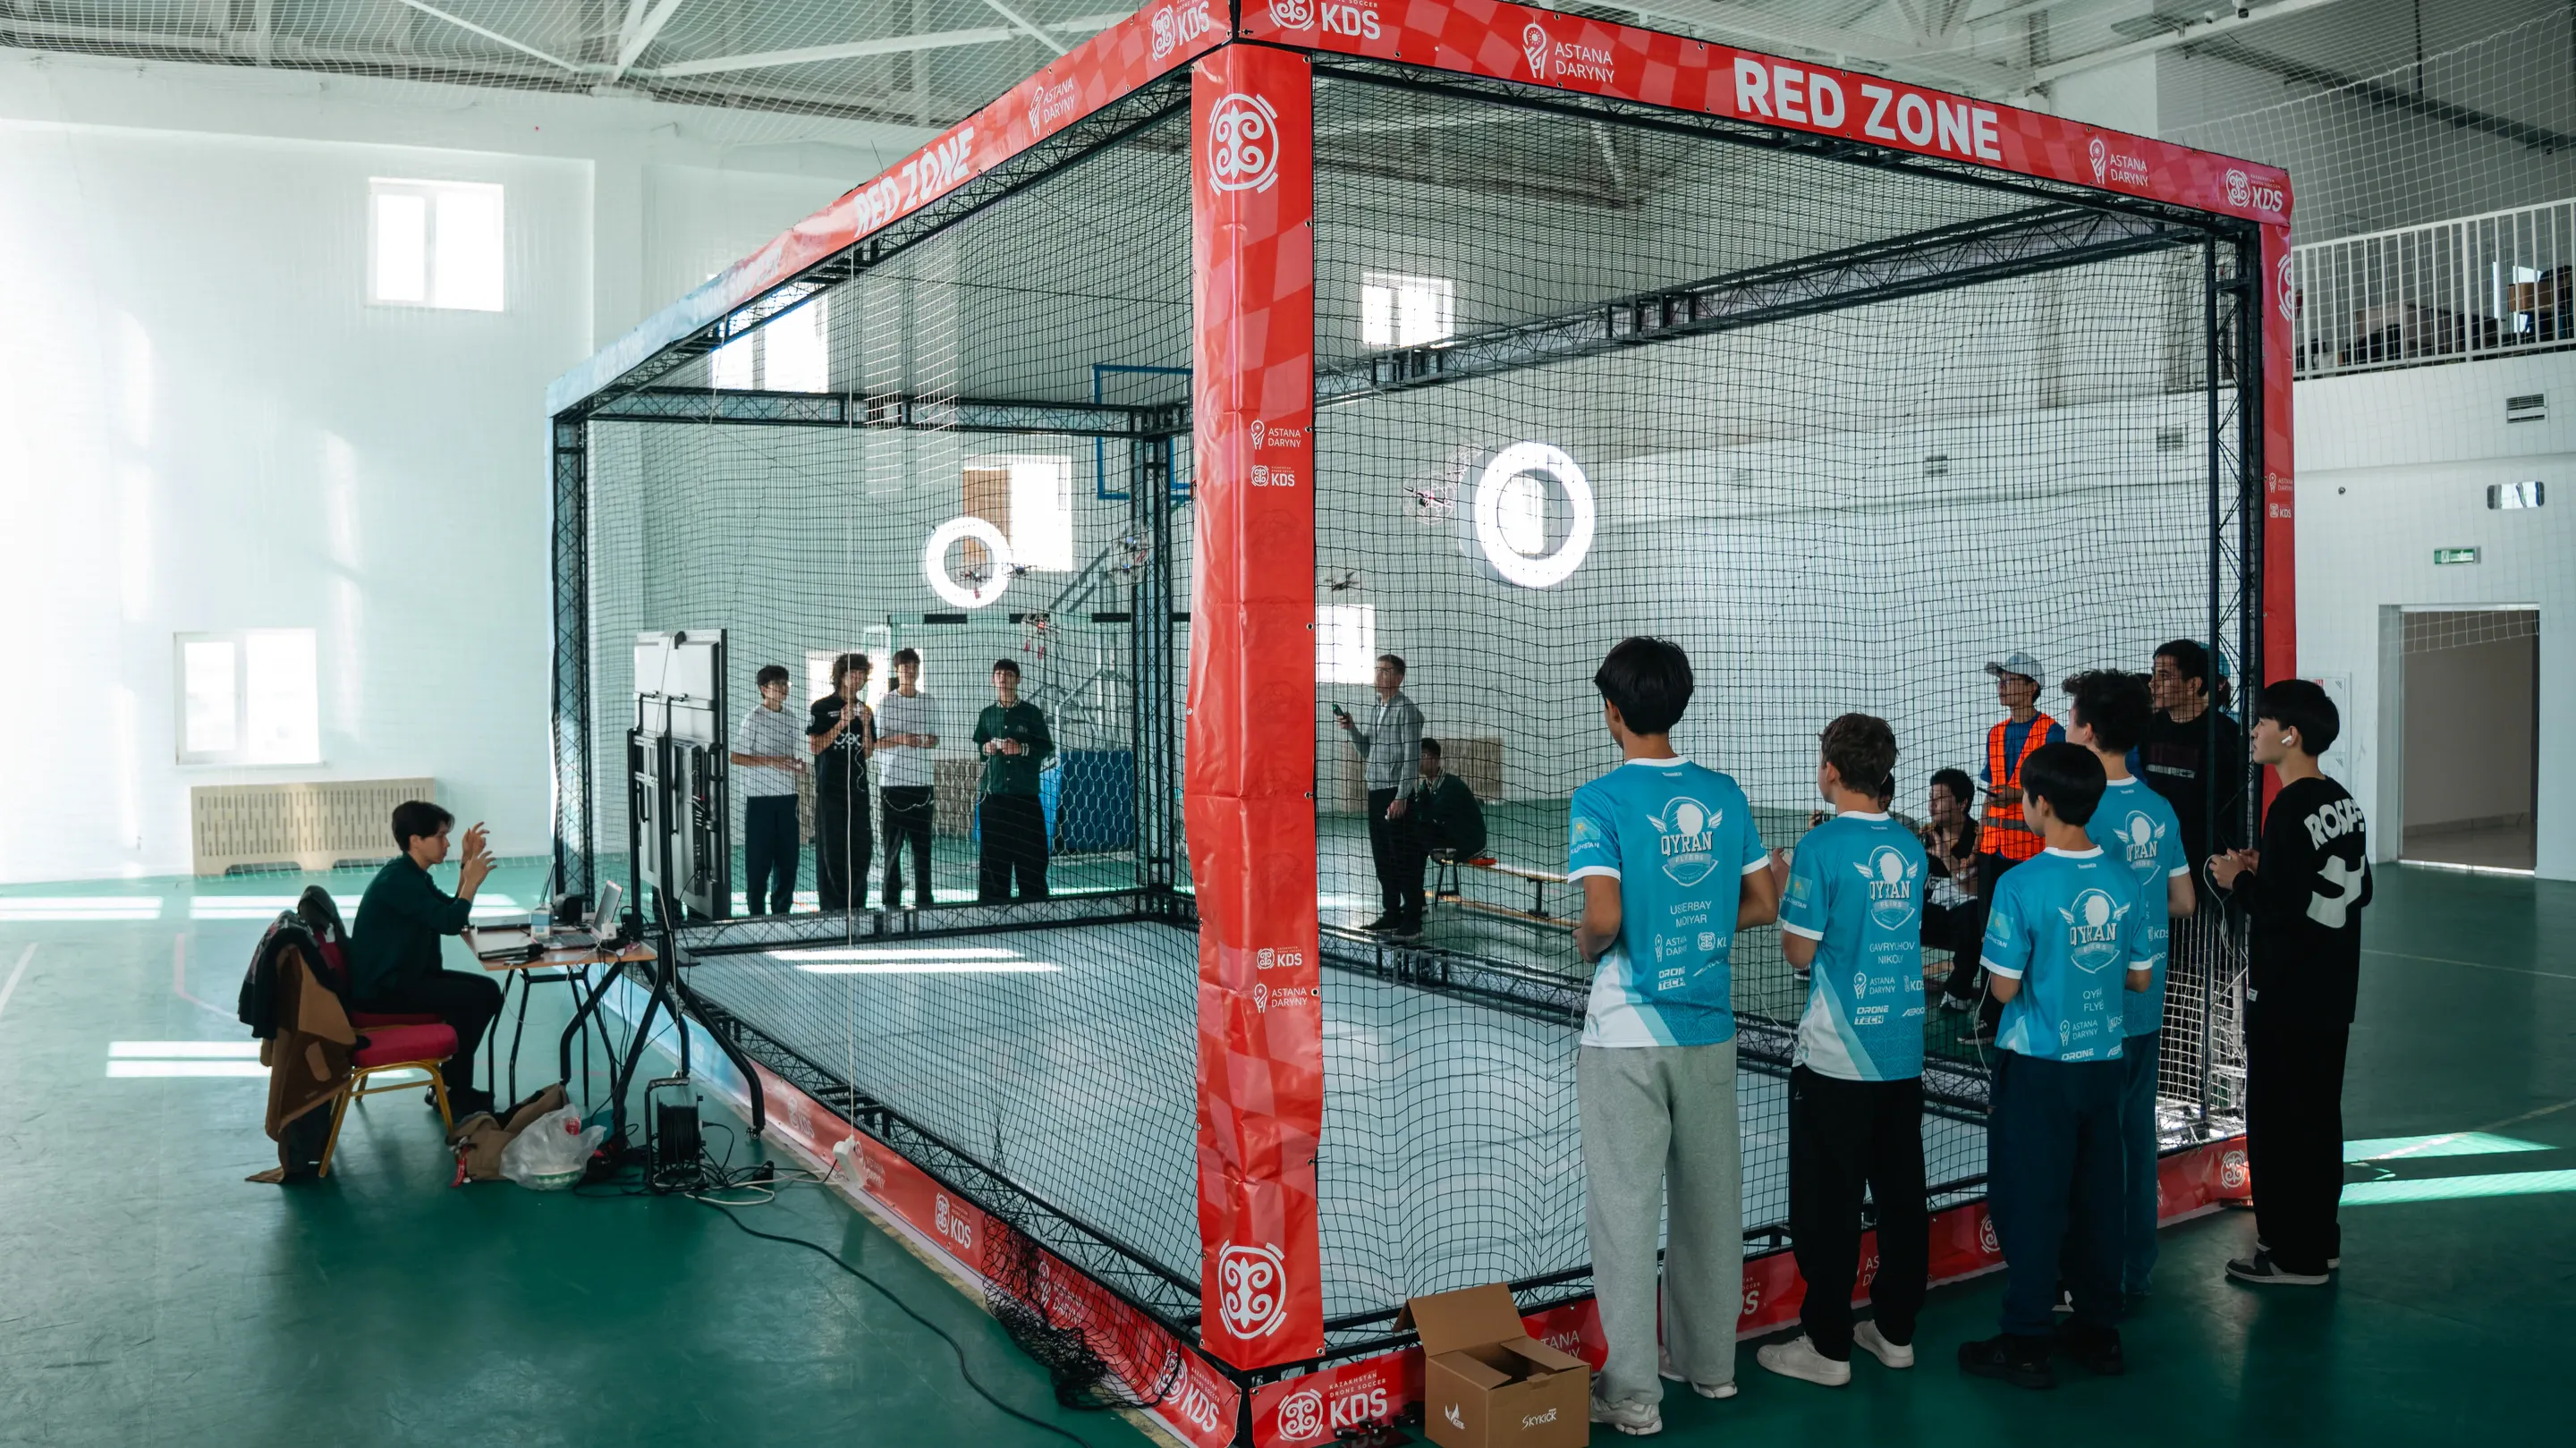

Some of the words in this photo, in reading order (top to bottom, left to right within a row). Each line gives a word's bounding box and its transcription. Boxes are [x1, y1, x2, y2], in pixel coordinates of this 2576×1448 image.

[1177, 1, 1209, 46] KDS
[1321, 2, 1380, 39] KDS
[1555, 42, 1613, 65] ASTANA
[1555, 60, 1614, 83] DARYNY
[1043, 78, 1073, 106] ASTANA
[1044, 94, 1075, 123] DARYNY
[1733, 56, 1845, 128] RED
[1861, 83, 2001, 161] ZONE
[2110, 153, 2147, 173] ASTANA
[853, 176, 900, 238] RED
[902, 126, 974, 212] ZONE
[2110, 168, 2148, 187] DARYNY
[2252, 185, 2283, 212] KDS
[1267, 428, 1301, 437] ASTANA
[1267, 437, 1301, 448] DARYNY
[1271, 473, 1295, 487] KDS
[2279, 508, 2292, 519] KDS
[1661, 831, 1712, 857] QYRAN
[2070, 922, 2117, 946] QYRAN
[1277, 953, 1302, 967] KDS
[1869, 976, 1895, 986] ASTANA
[1869, 986, 1895, 995] DARYNY
[1271, 987, 1307, 997] ASTANA
[1271, 997, 1308, 1008] DARYNY
[1857, 1005, 1889, 1015] DRONE
[1854, 1015, 1884, 1025] TECH
[2072, 1020, 2098, 1031] ASTANA
[2072, 1028, 2098, 1040] DARYNY
[2061, 1047, 2094, 1061] DRONE
[951, 1215, 971, 1249] KDS
[1540, 1330, 1580, 1350] TANA
[1329, 1373, 1377, 1390] KAZAKHSTAN
[1329, 1386, 1355, 1398] DRONE
[1358, 1377, 1386, 1391] SOCCER
[1181, 1383, 1219, 1432] KDS
[1330, 1387, 1388, 1429] KDS
